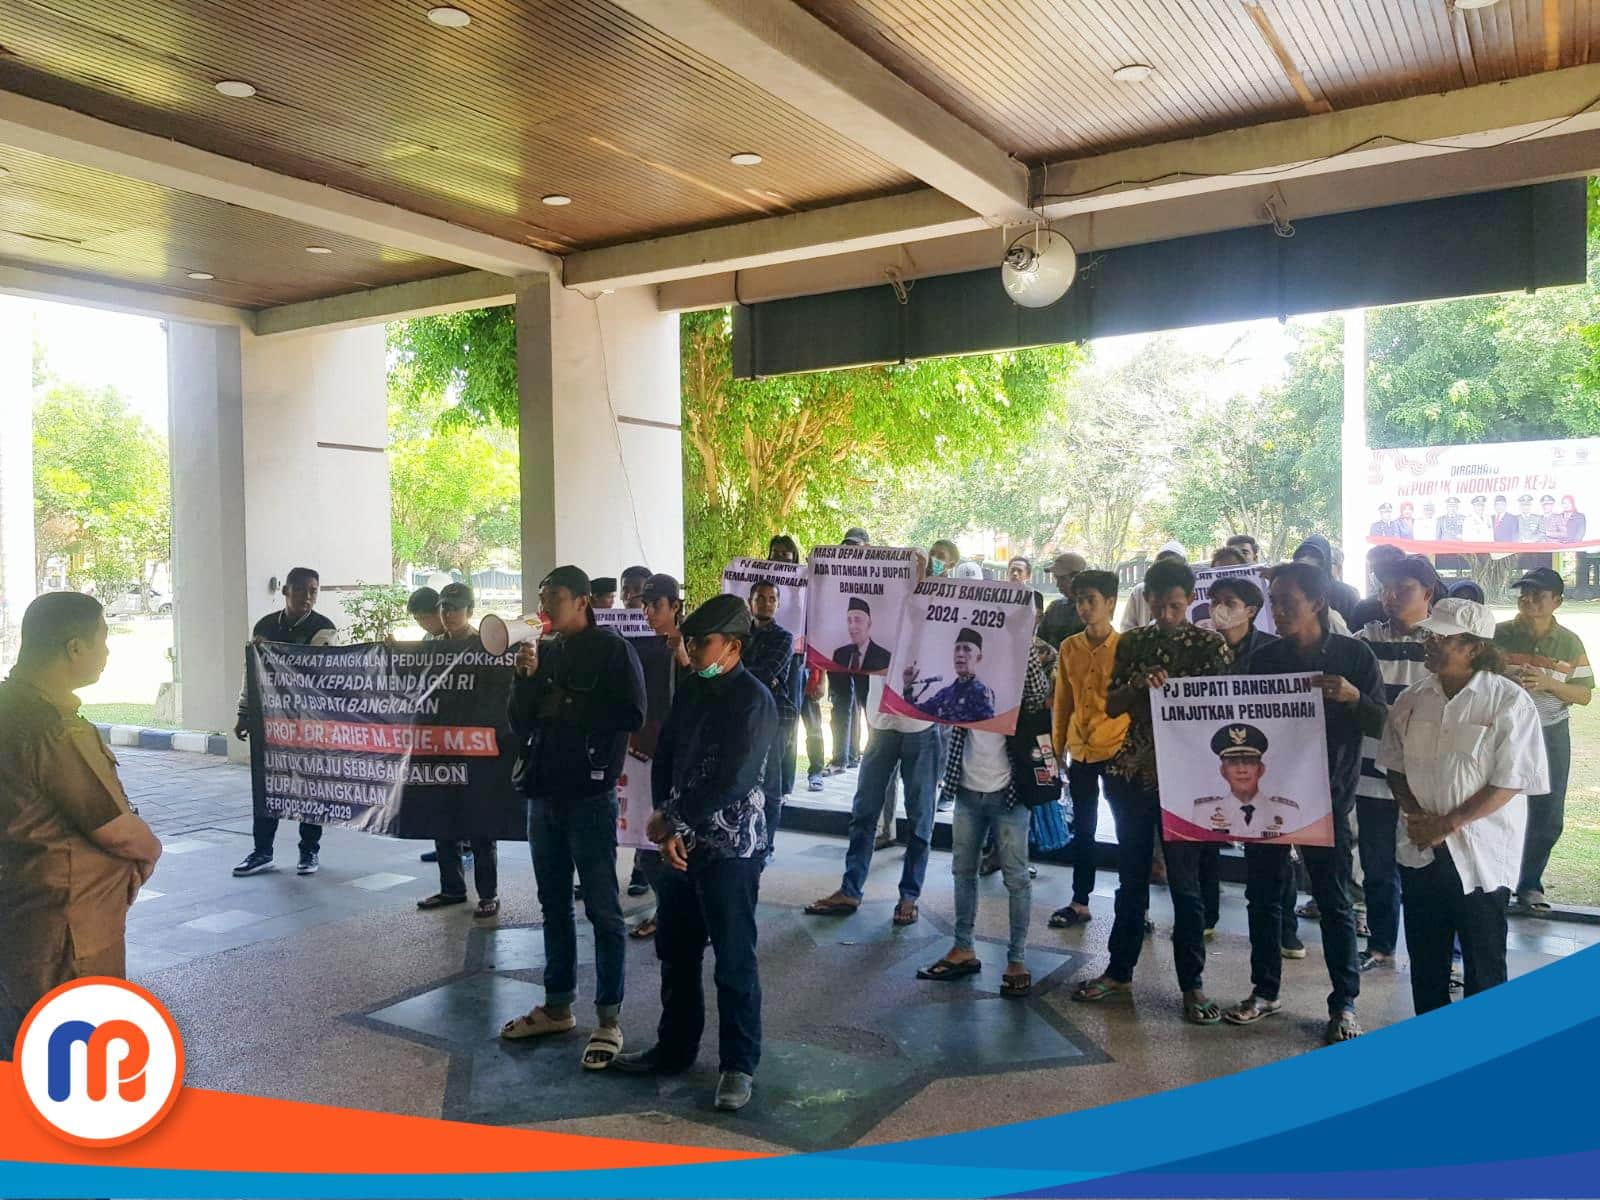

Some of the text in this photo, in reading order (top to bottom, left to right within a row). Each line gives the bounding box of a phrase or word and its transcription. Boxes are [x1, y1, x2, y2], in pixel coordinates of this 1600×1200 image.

[813, 547, 912, 561] MASA DEPAN BANGKALAN
[740, 559, 798, 573] PJ ARIEF UNTUK
[814, 563, 911, 579] ADA DITANGAN PJ BUPATI
[839, 582, 884, 595] BANGKALAN
[913, 582, 1033, 606] BUPATI BANGKALAN
[926, 604, 960, 623] 2024
[970, 609, 1006, 629] 2029
[325, 654, 389, 668] BANGKALAN
[391, 653, 433, 668] PEDULI
[434, 650, 518, 667] DEMOKRASI
[316, 674, 374, 691] KEPADA
[376, 673, 454, 691] MENDAGRI
[457, 673, 475, 690] RI
[1162, 677, 1312, 698] PJ BUPATI BANGKALAN
[262, 693, 440, 714] AGAR PJ BUPATI BANGKALAN
[1160, 701, 1316, 721] LANJUTKAN PERUBAHAN
[303, 723, 329, 744] DR.
[331, 725, 370, 745] ARIEF
[370, 727, 391, 747] M.
[391, 728, 439, 752] EDIE,
[443, 730, 495, 752] M.SI
[263, 751, 467, 783] UNTUK MAJU SEBAGAI CALON
[264, 775, 387, 805] BUPATI BANGKALAN
